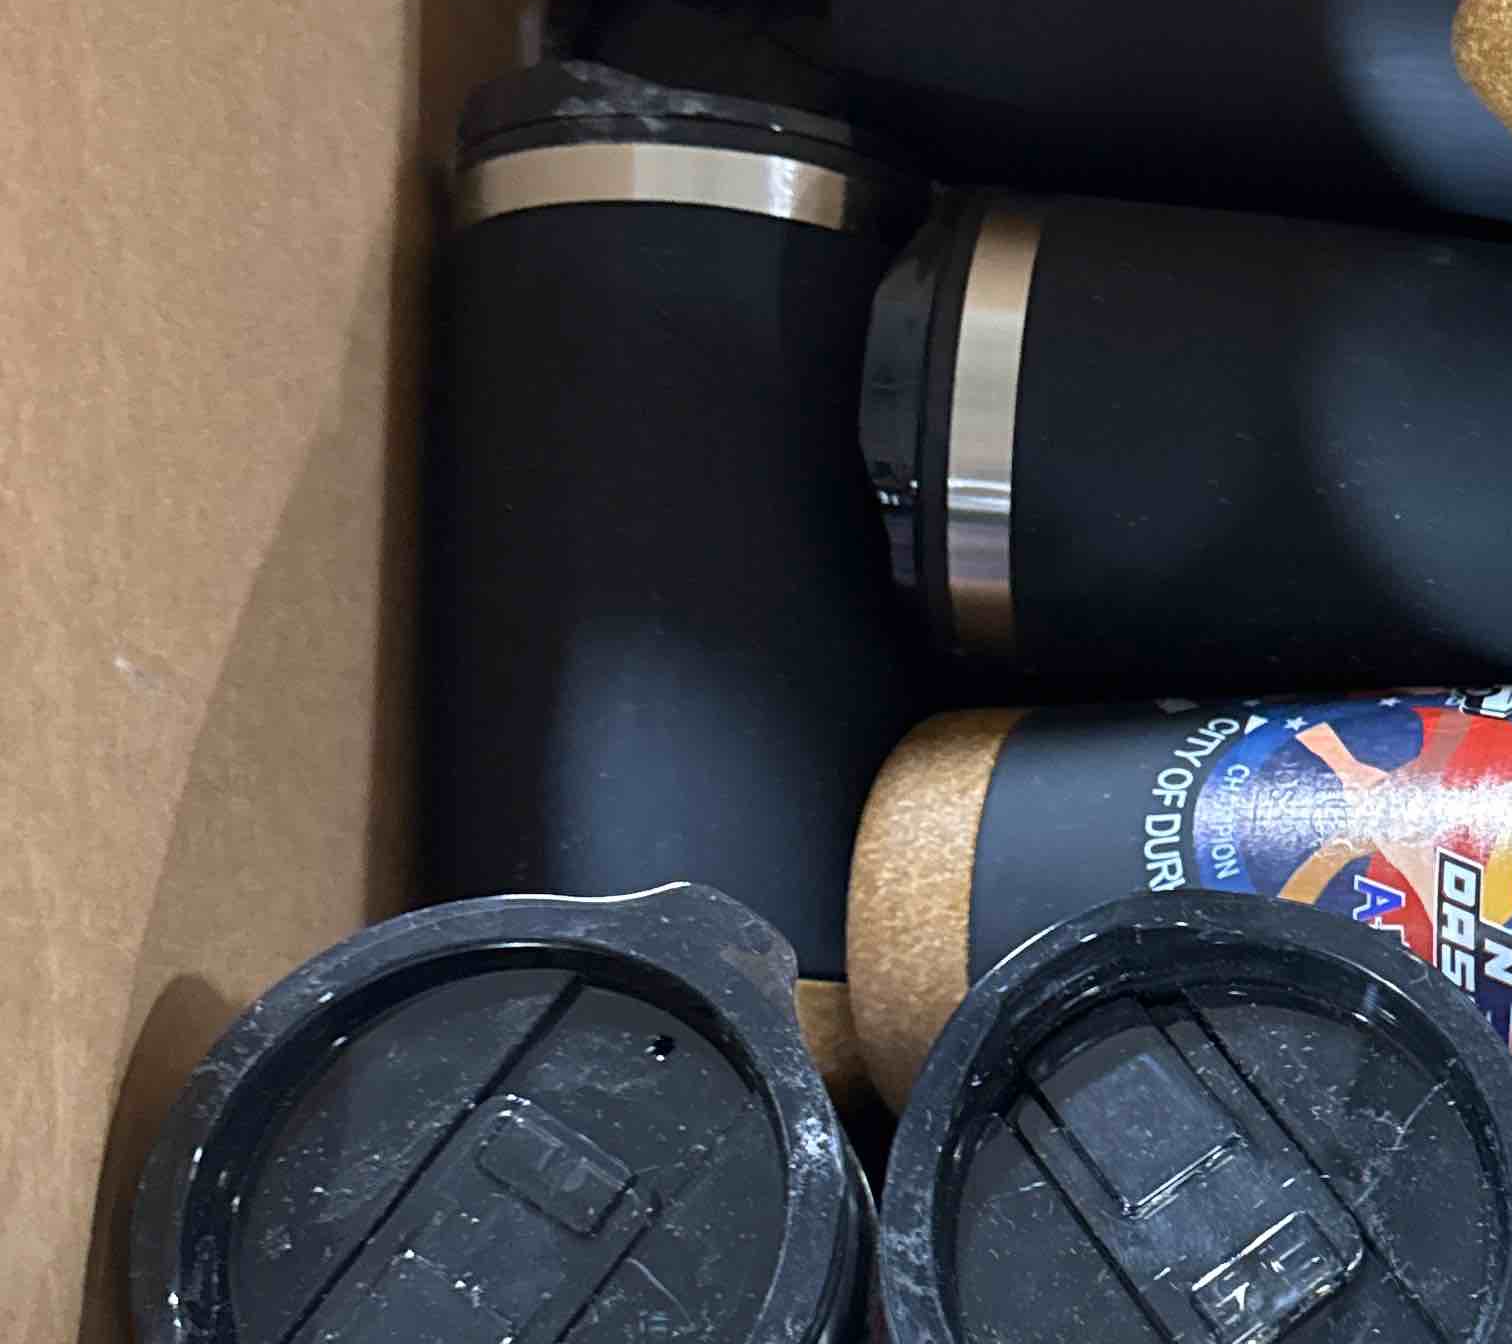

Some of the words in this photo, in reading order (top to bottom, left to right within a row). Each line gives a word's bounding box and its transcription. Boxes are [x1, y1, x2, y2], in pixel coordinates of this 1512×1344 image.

[1173, 718, 1240, 767] CITY
[1151, 768, 1193, 808] OF
[1440, 859, 1477, 996] DAS
